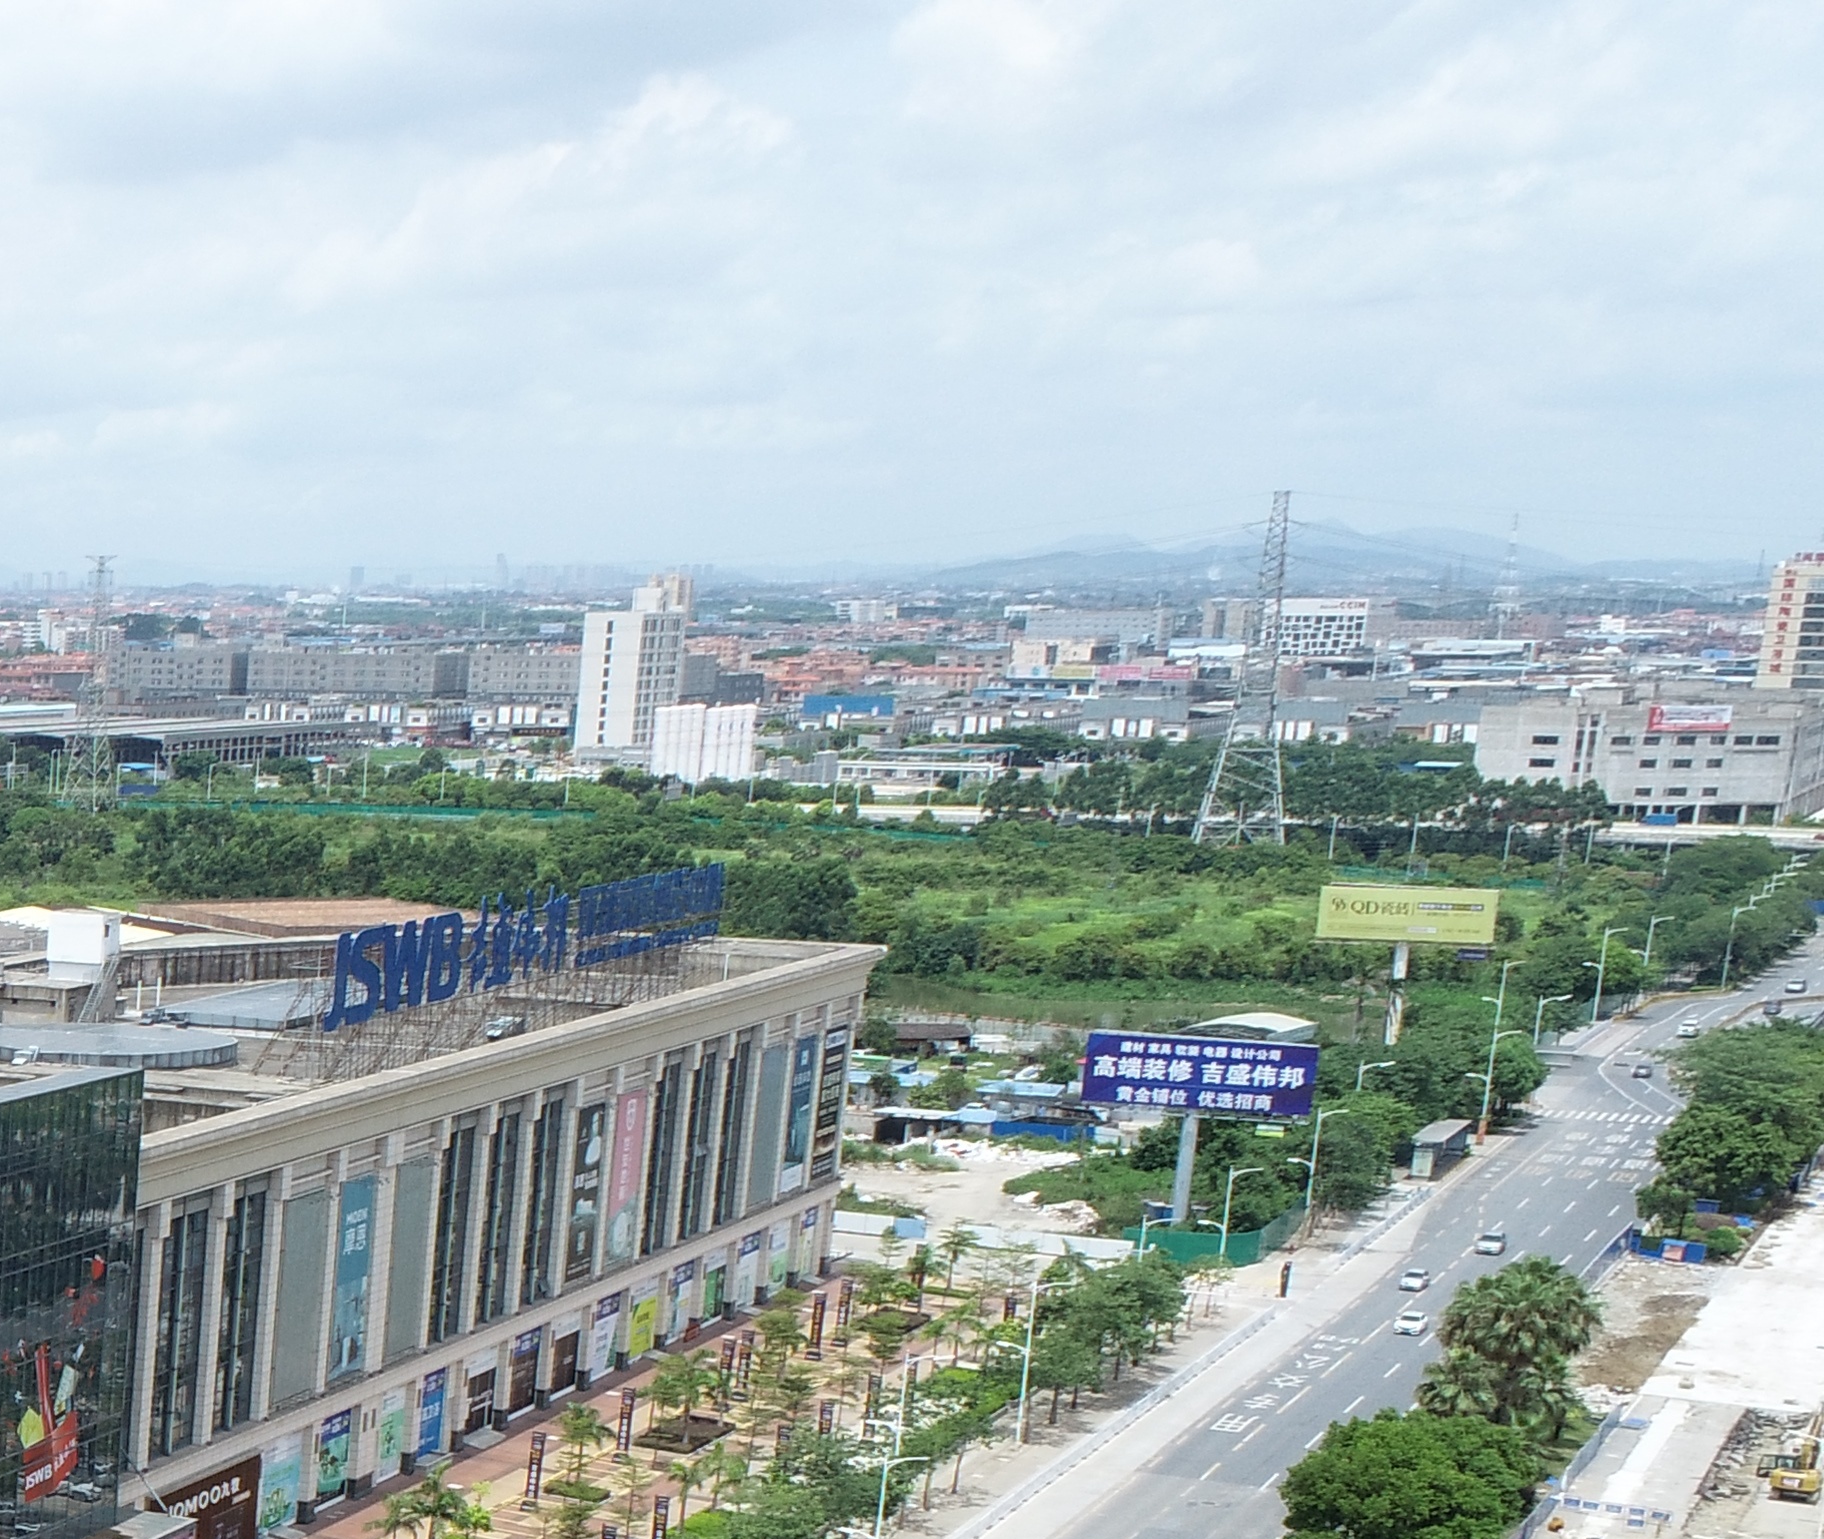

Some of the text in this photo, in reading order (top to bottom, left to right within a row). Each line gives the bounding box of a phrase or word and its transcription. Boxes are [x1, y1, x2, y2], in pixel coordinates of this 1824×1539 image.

[1350, 900, 1380, 916] QD
[324, 912, 463, 1032] JSWB
[1093, 1055, 1306, 1090] 高端装修 吉盛伟邦
[1116, 1085, 1273, 1112] 黄金铺位 优选招商
